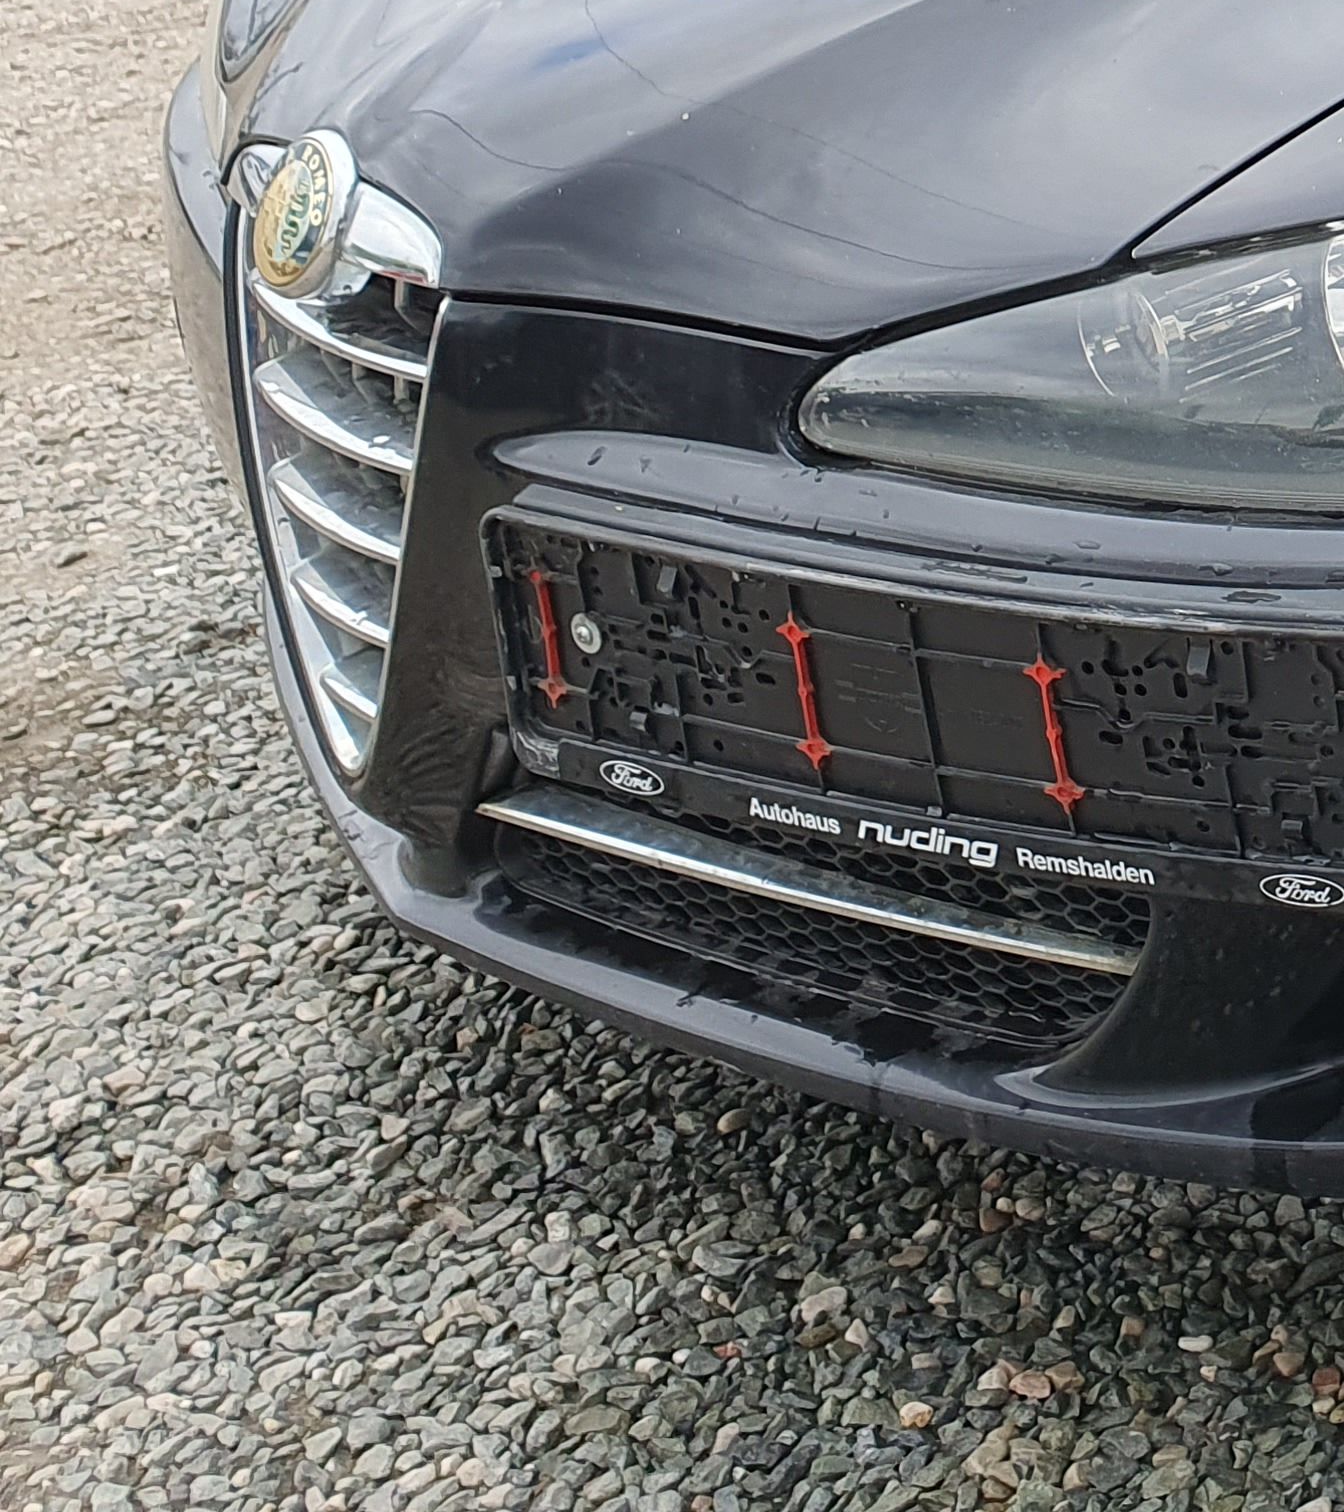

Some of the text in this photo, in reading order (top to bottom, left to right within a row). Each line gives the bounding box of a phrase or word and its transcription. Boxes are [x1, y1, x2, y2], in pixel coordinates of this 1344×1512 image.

[301, 143, 327, 227] ROMEO
[748, 796, 1156, 886] Autohaus nuding Remshalden
